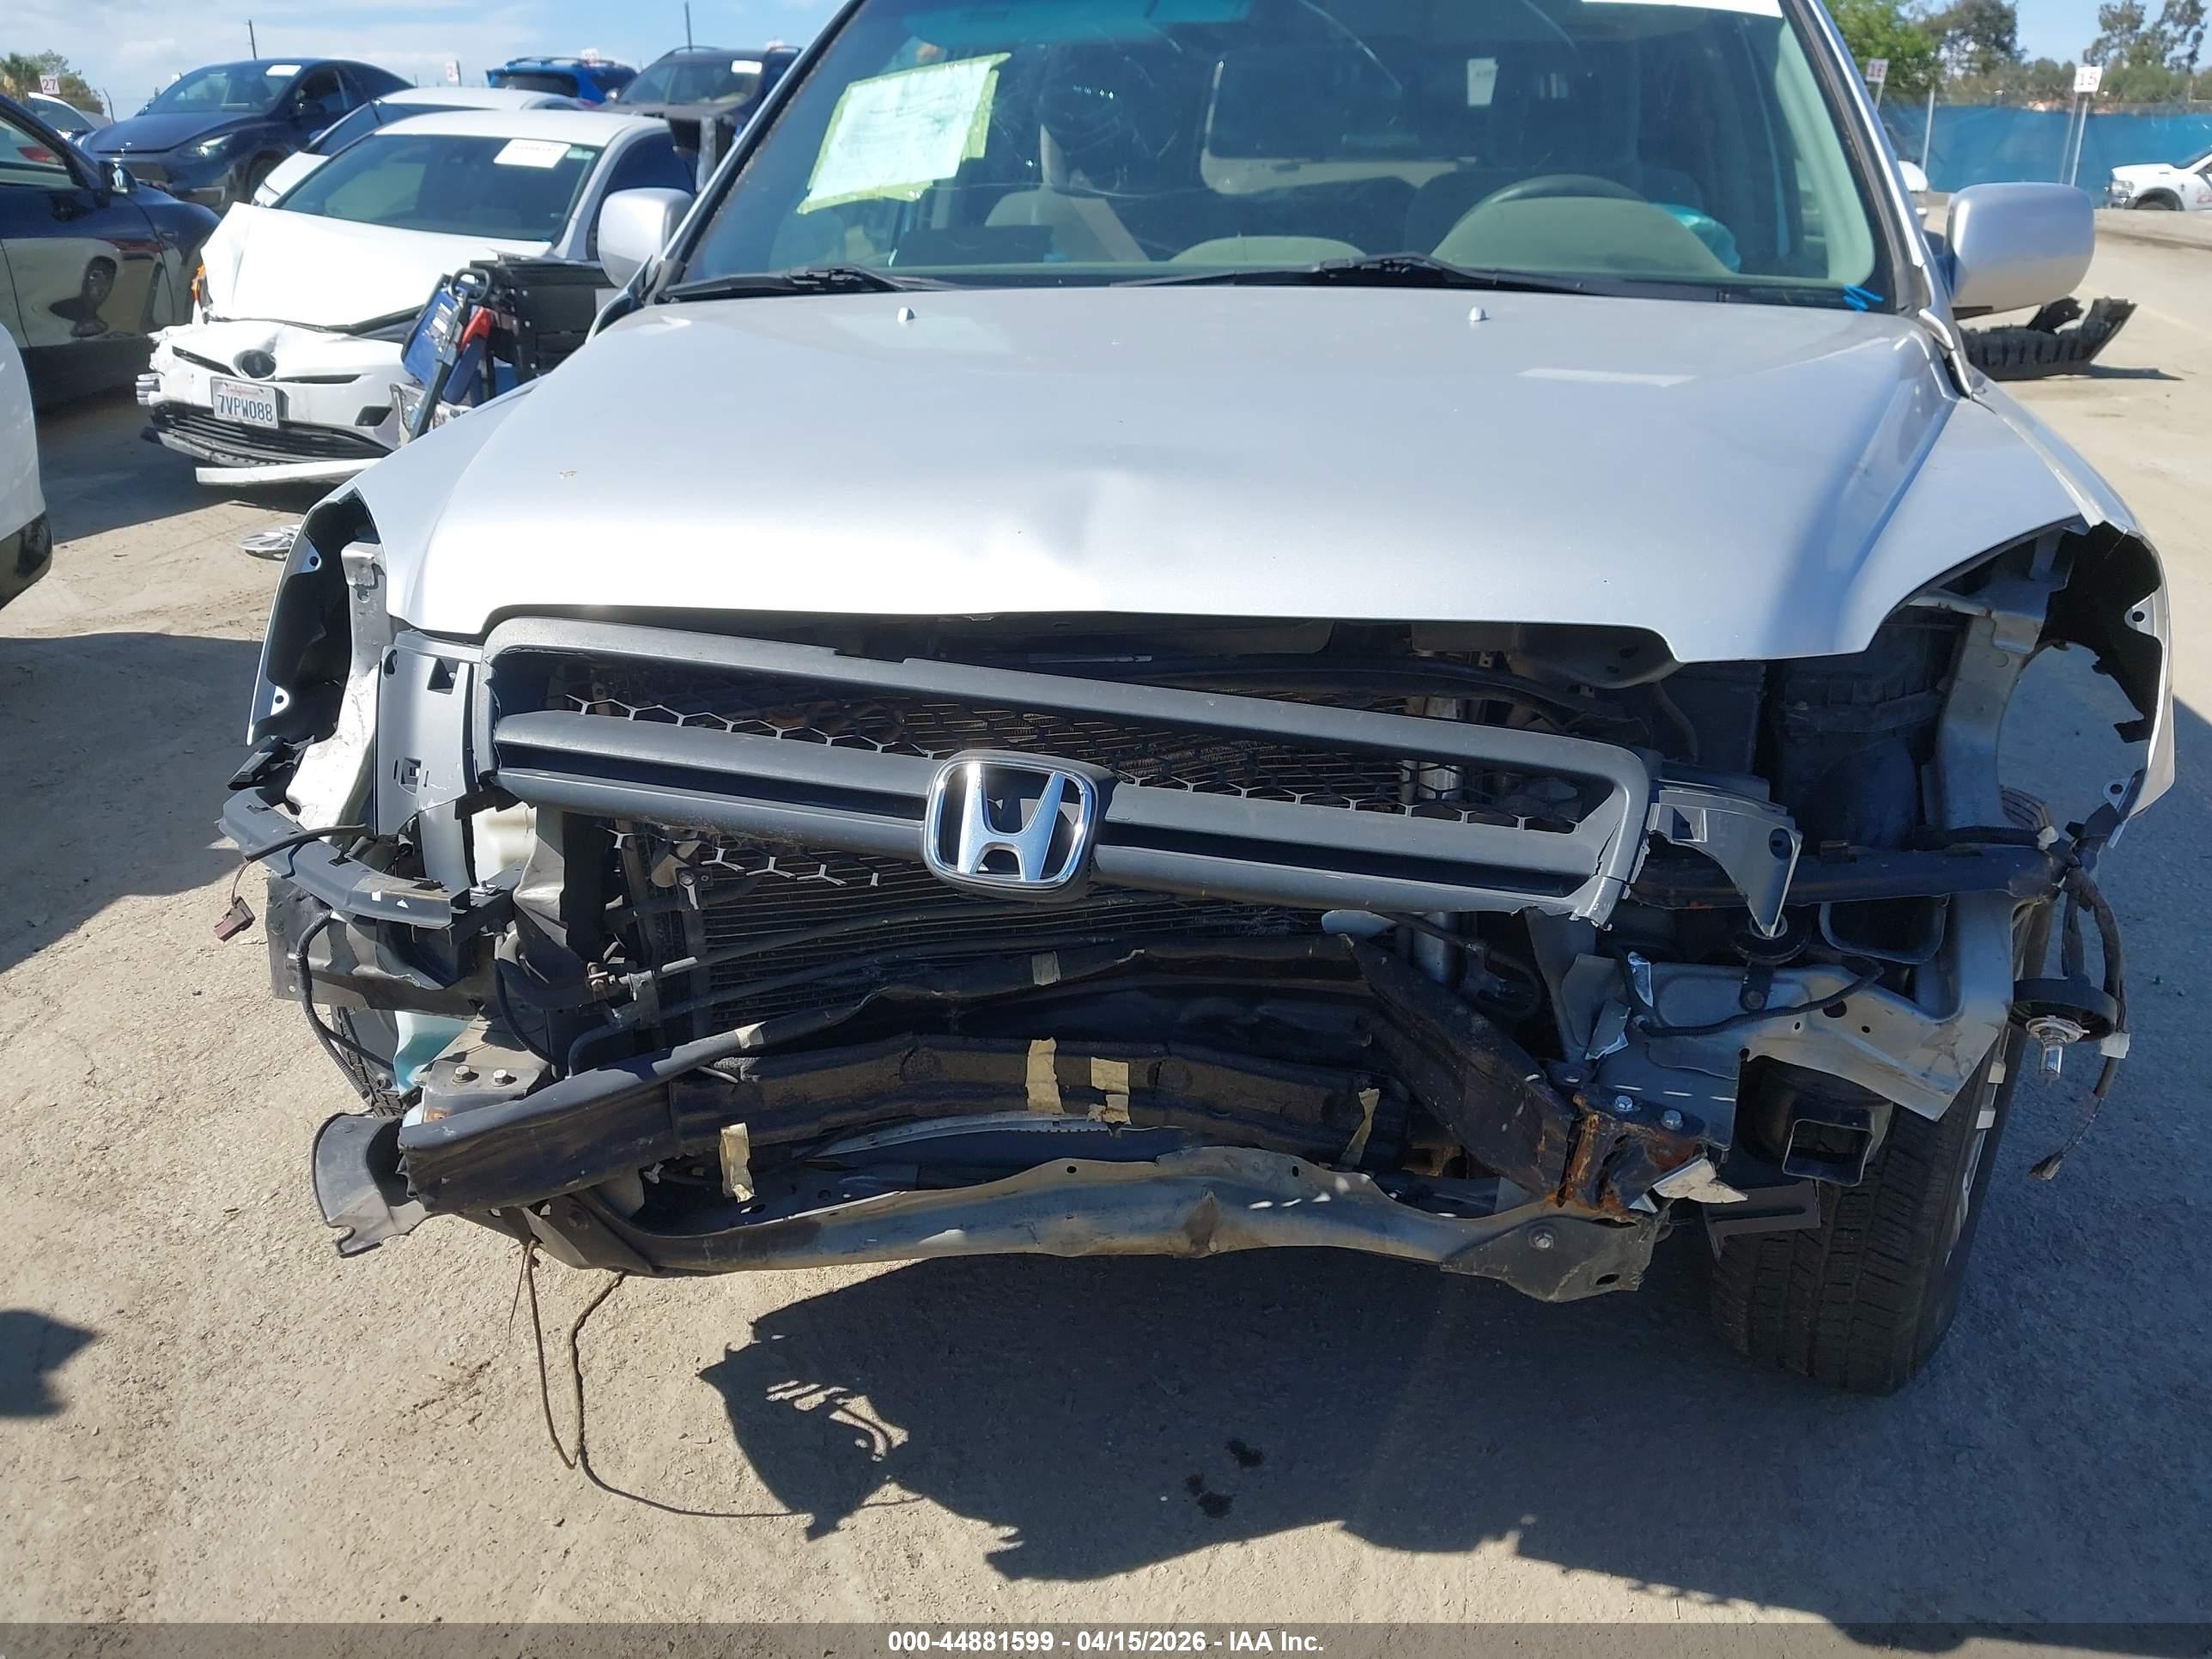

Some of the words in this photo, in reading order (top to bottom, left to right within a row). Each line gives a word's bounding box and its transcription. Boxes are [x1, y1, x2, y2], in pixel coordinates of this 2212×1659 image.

[42, 78, 56, 91] 27
[2080, 71, 2098, 86] 15
[217, 394, 273, 422] 7VPW088
